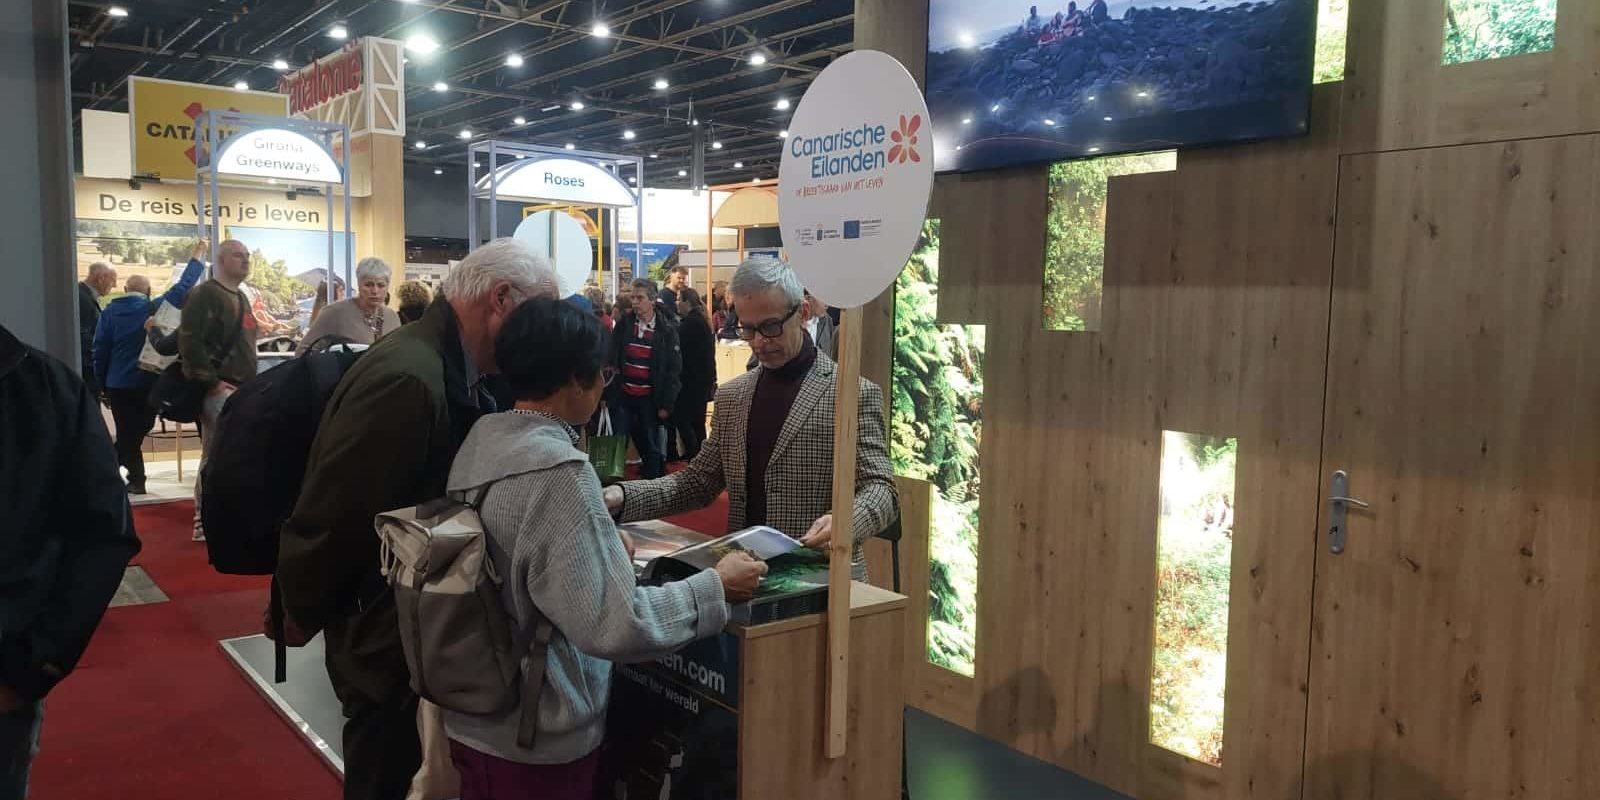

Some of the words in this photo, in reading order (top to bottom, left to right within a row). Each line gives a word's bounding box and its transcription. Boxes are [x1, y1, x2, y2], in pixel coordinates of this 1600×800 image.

[791, 124, 886, 158] Canarische
[236, 154, 320, 174] Greenways
[811, 149, 885, 178] Eilanden
[544, 172, 585, 187] Roses
[99, 193, 132, 212] De
[141, 197, 184, 215] reis
[191, 203, 231, 218] van
[237, 202, 257, 222] je
[265, 204, 320, 223] leven
[656, 653, 726, 694] en.com
